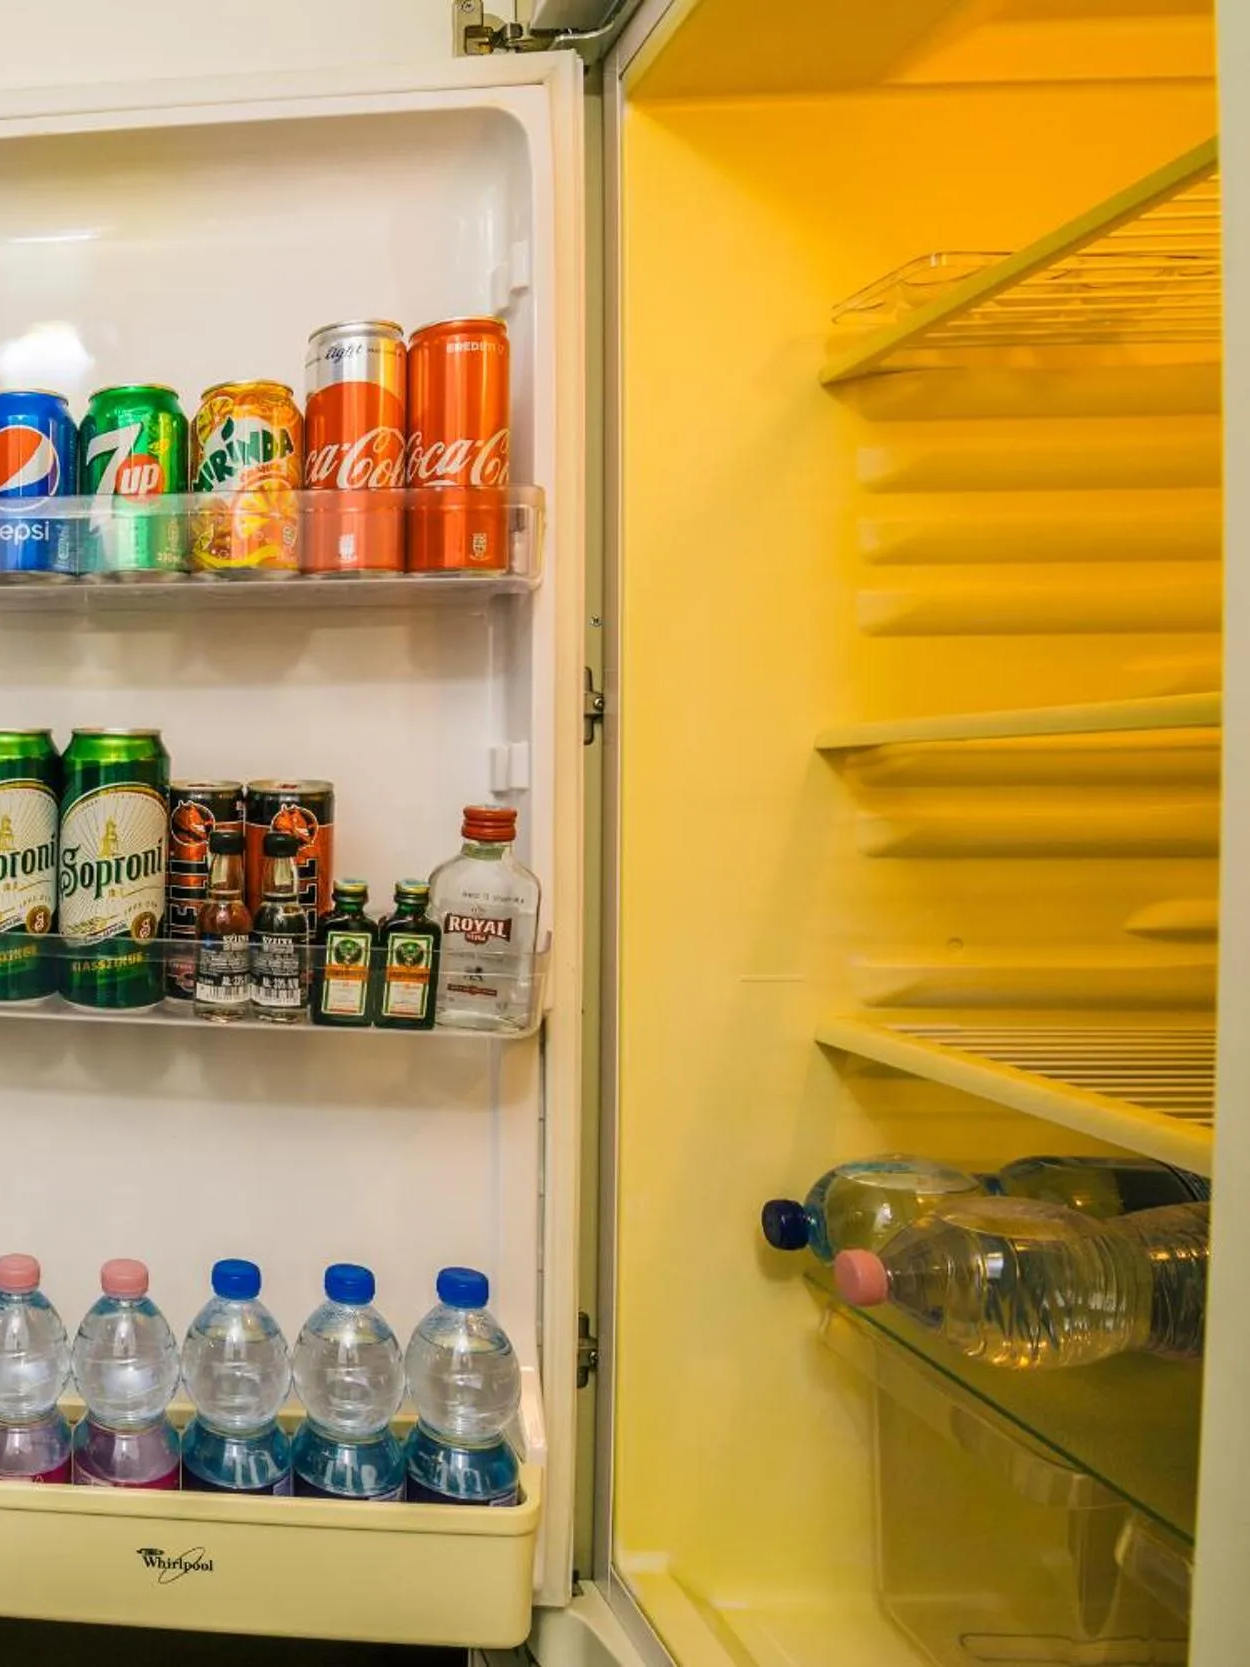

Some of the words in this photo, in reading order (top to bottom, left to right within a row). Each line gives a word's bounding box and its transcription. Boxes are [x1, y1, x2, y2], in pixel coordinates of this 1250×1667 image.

[59, 838, 163, 901] Soproni
[448, 915, 507, 938] ROYAL
[141, 1554, 213, 1574] Whirlpool
